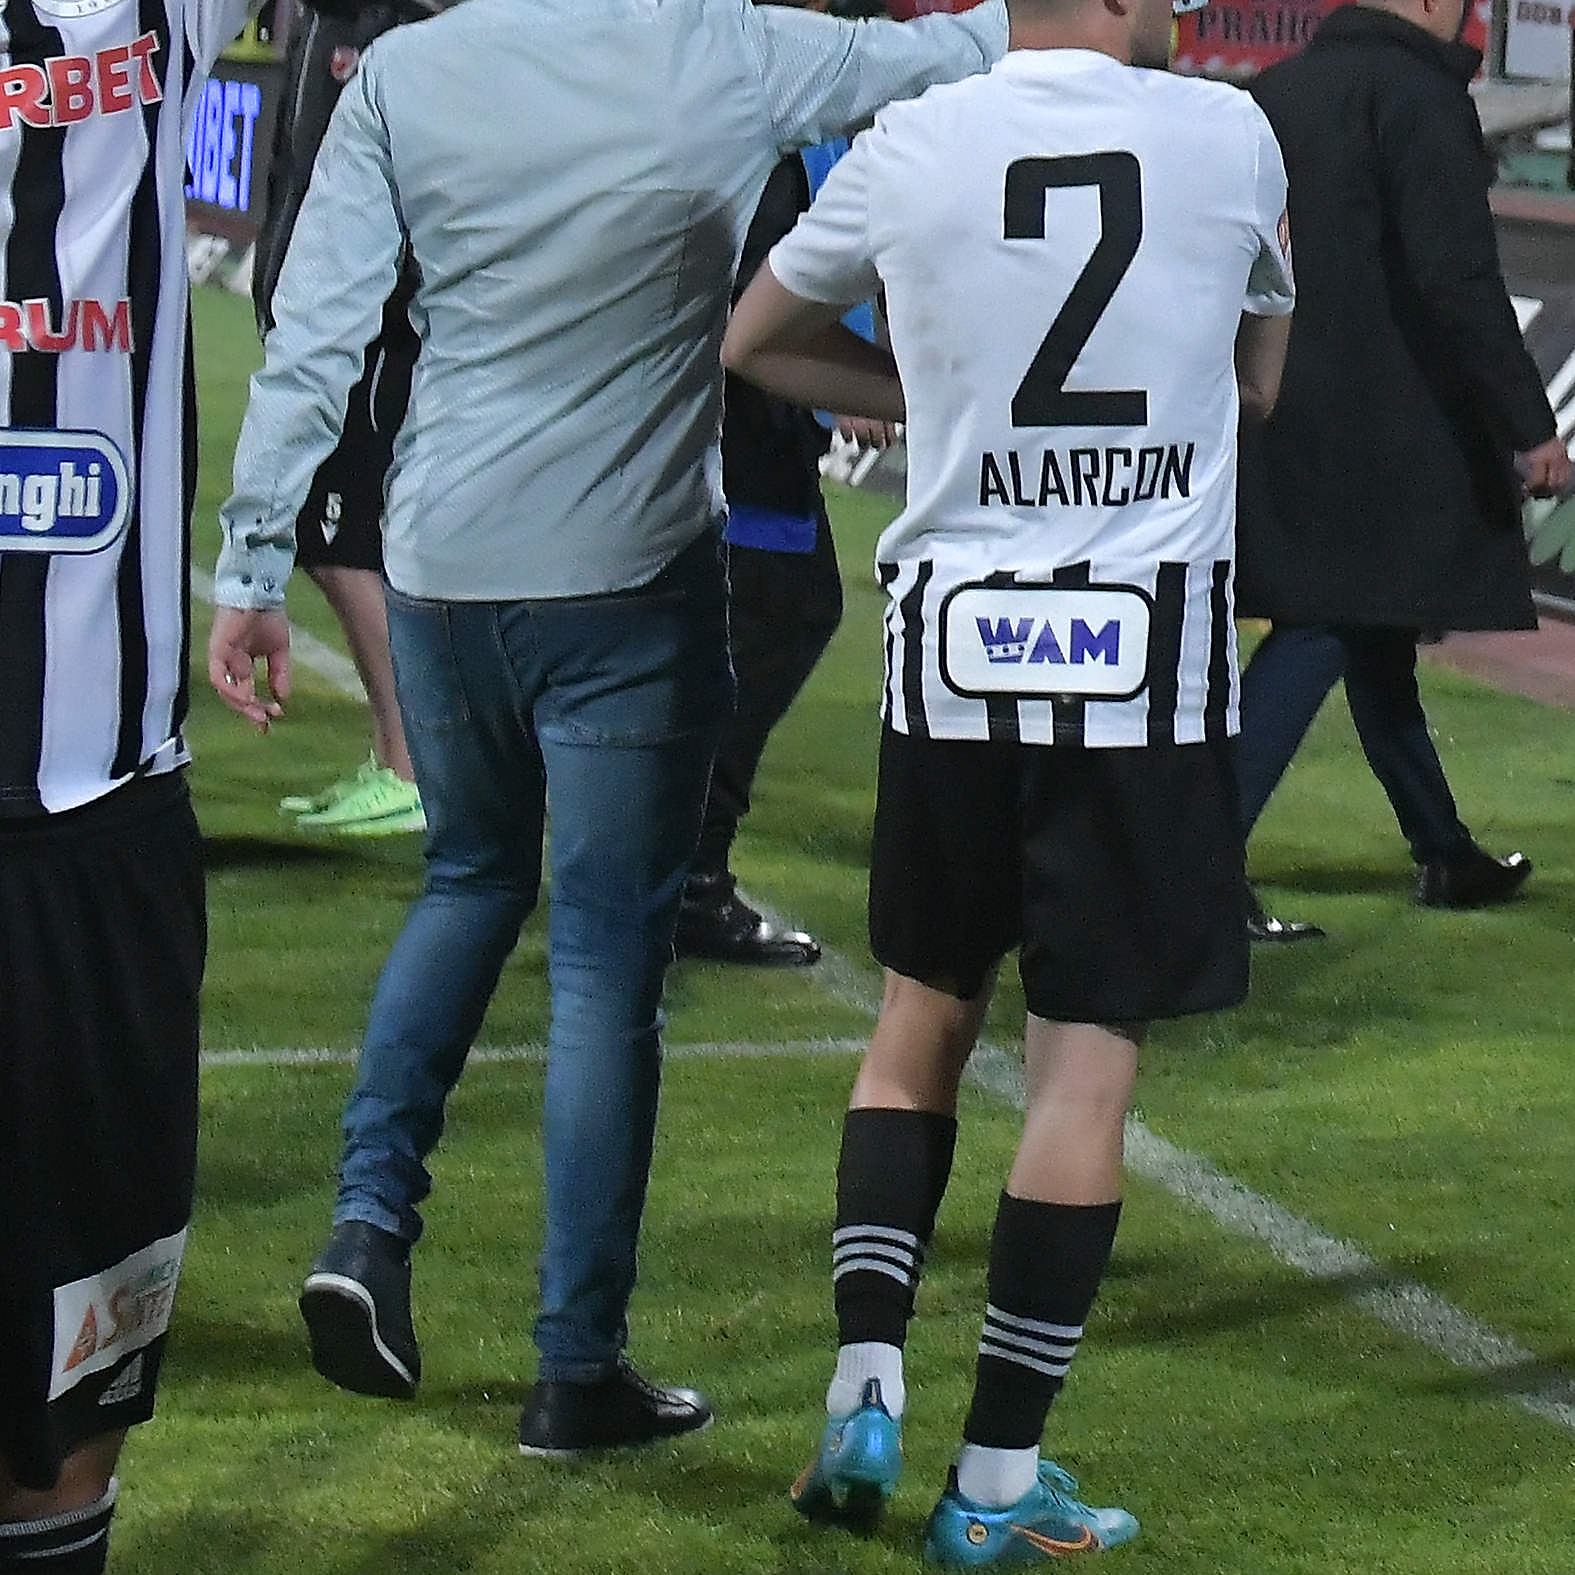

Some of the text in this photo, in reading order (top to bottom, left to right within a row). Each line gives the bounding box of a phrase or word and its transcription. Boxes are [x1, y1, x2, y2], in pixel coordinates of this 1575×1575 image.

[1003, 151, 1148, 428] 2
[979, 443, 1195, 507] ALARCON
[975, 616, 1121, 666] WAM
